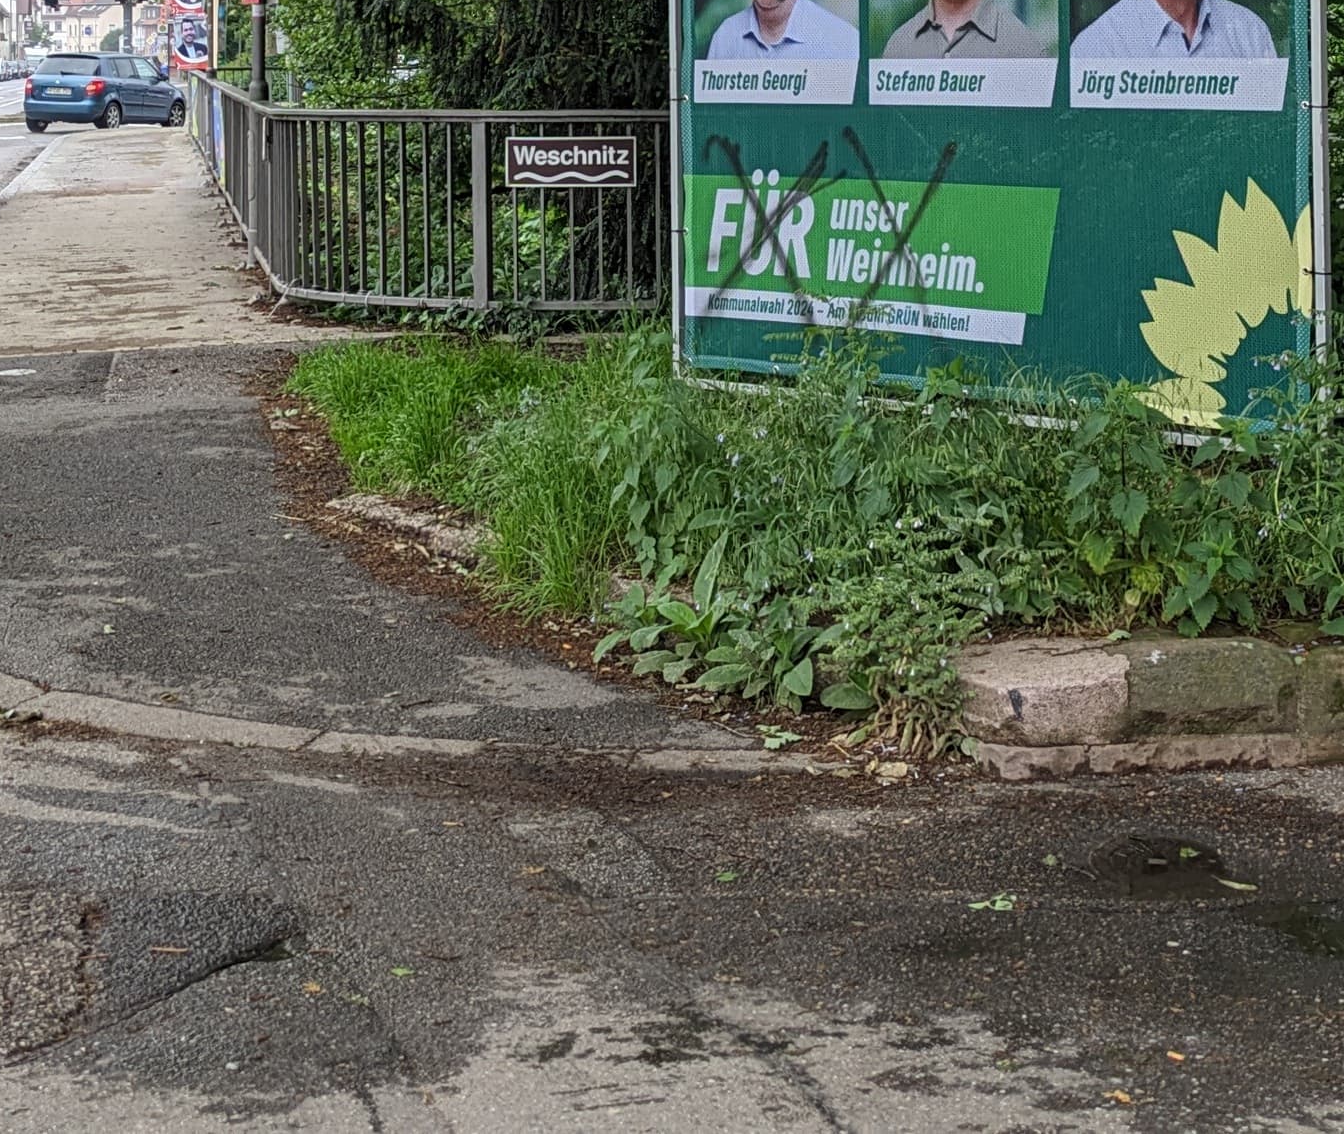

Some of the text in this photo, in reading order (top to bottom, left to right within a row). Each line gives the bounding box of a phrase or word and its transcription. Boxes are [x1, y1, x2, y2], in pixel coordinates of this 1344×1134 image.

[701, 69, 808, 96] Thorsten Georgi
[876, 70, 986, 93] Stefano Bauer
[1077, 69, 1240, 100] Jörg Steinbrenner
[512, 144, 630, 166] Weschnitz
[706, 168, 816, 279] FÜR
[829, 197, 910, 233] unser
[707, 293, 786, 315] Kommunalwahl
[786, 298, 815, 317] 2024
[826, 303, 846, 320] Am
[886, 305, 921, 327] GRÜN
[922, 312, 971, 333] wählen!
